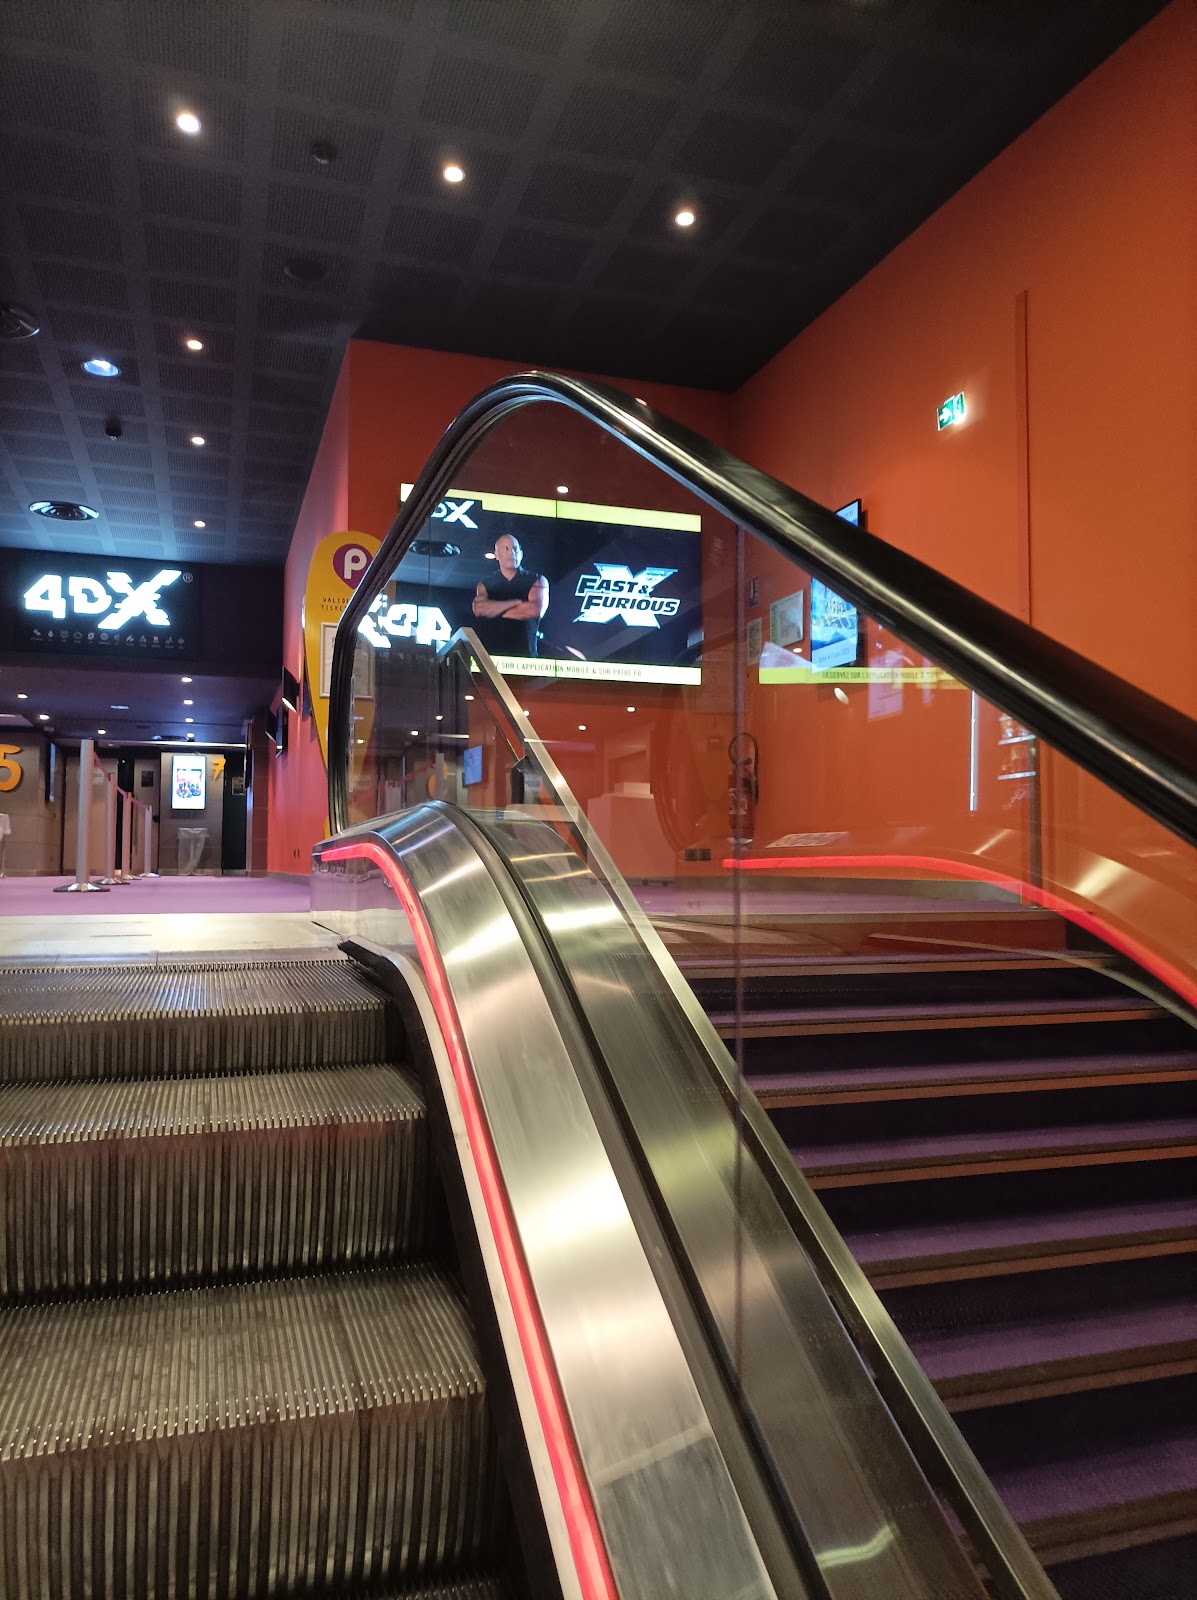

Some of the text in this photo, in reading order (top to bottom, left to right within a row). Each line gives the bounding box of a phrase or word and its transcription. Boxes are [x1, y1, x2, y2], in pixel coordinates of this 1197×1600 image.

[430, 500, 479, 529] DX
[577, 577, 639, 594] FAST
[321, 604, 347, 612] TICKE
[583, 595, 678, 613] FURIOUS
[501, 662, 515, 670] SUR
[566, 666, 589, 674] MOBILE
